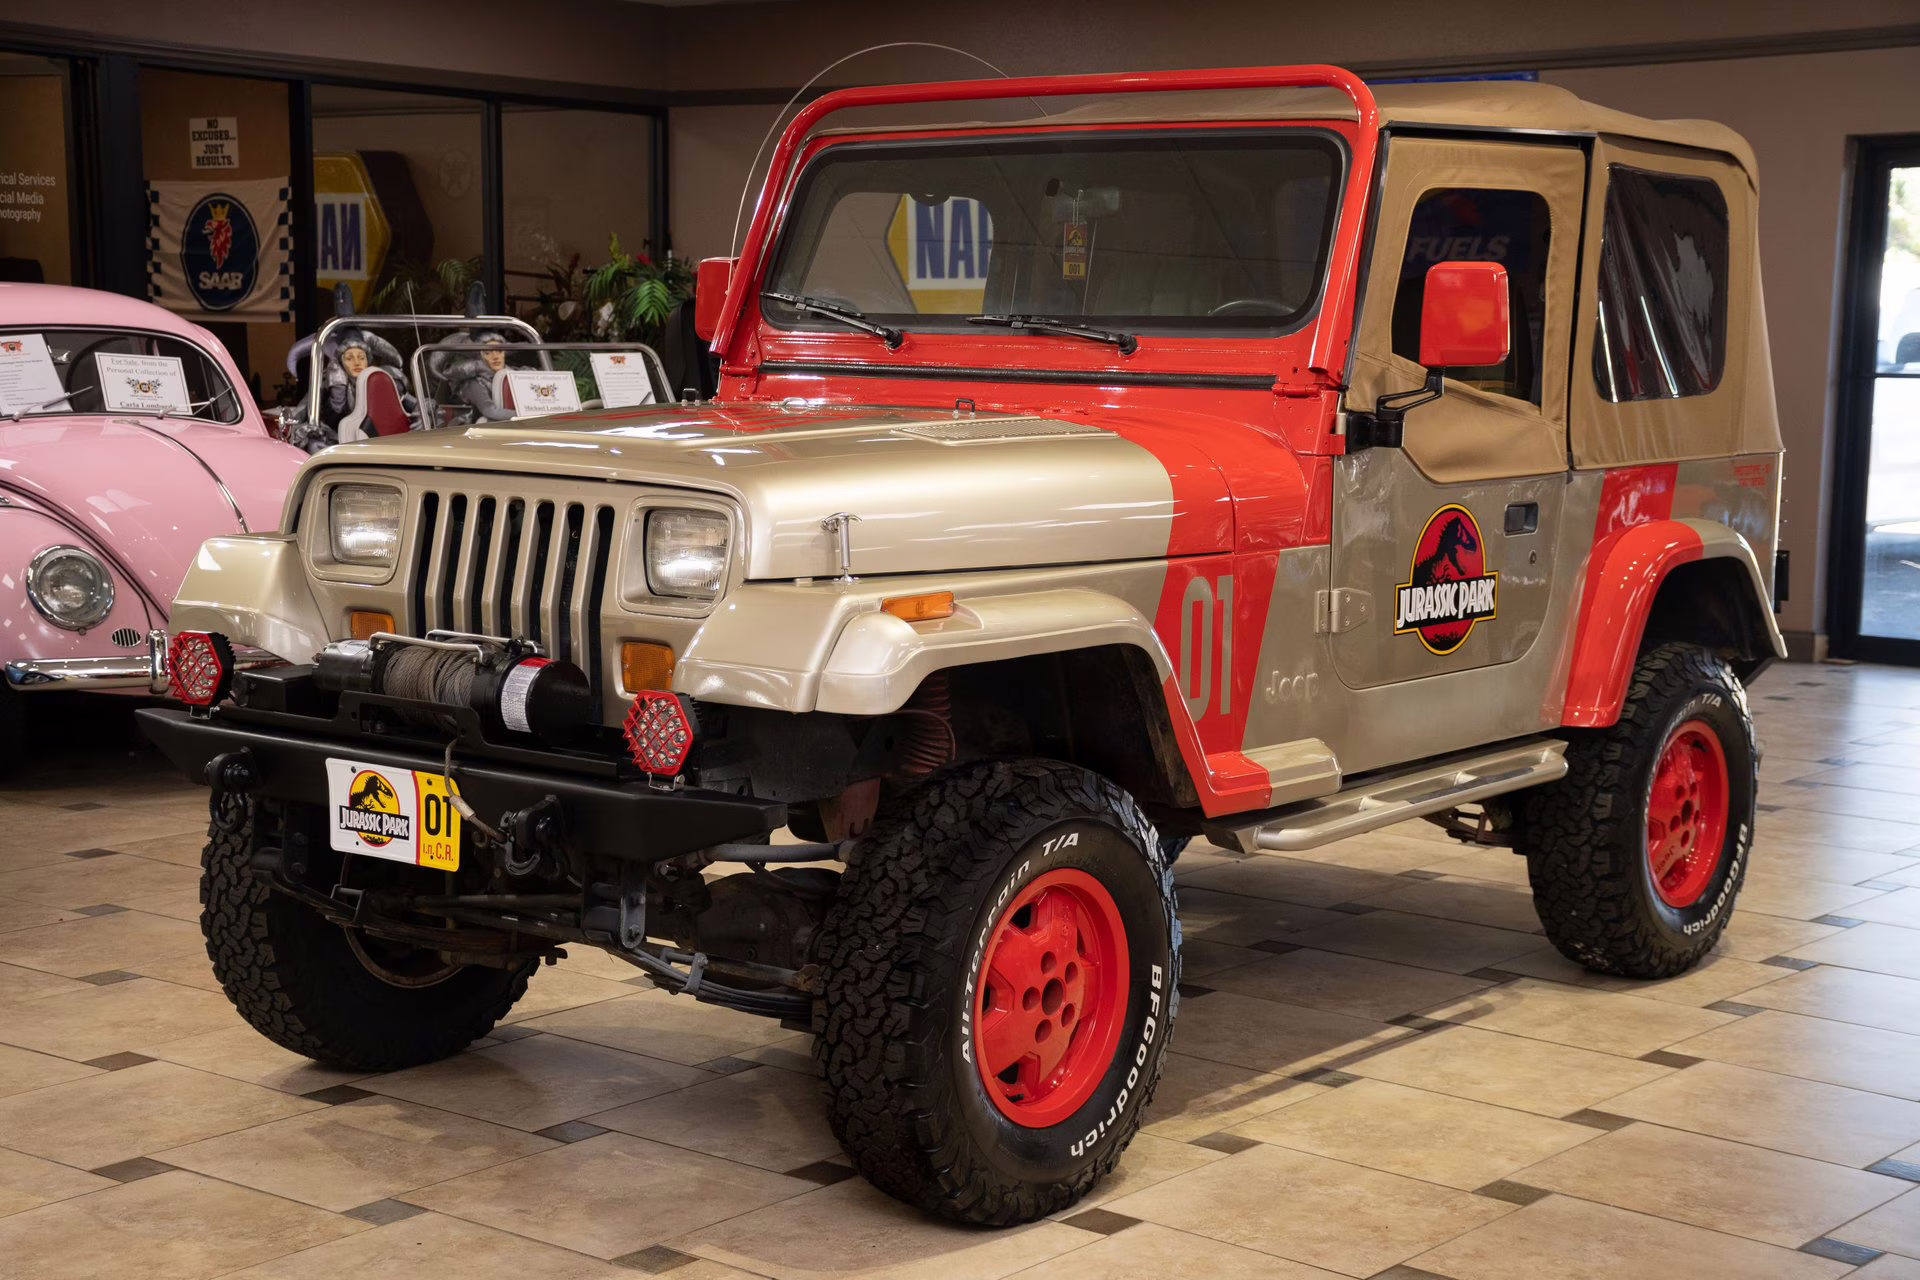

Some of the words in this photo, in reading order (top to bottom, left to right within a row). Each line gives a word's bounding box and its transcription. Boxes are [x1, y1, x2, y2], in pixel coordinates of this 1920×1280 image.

[207, 119, 218, 129] NO
[196, 155, 235, 166] RESULTS.
[203, 144, 224, 154] JUST
[18, 172, 57, 186] Services
[16, 191, 44, 205] Media
[1407, 233, 1511, 263] FUELS
[198, 271, 244, 290] SAAB
[106, 366, 133, 375] Personal
[1396, 582, 1459, 629] JURASSIC
[1458, 578, 1496, 620] PARK
[1179, 574, 1234, 722] 01
[1265, 670, 1319, 705] Jeep
[340, 806, 382, 832] JURASSIC
[382, 813, 409, 837] PARK
[424, 793, 452, 838] 01
[1682, 823, 1748, 936] BFGoodrich
[961, 859, 1030, 1064] All-Terrain
[1042, 832, 1079, 857] T/A
[1070, 964, 1162, 1158] BFGoodrich
